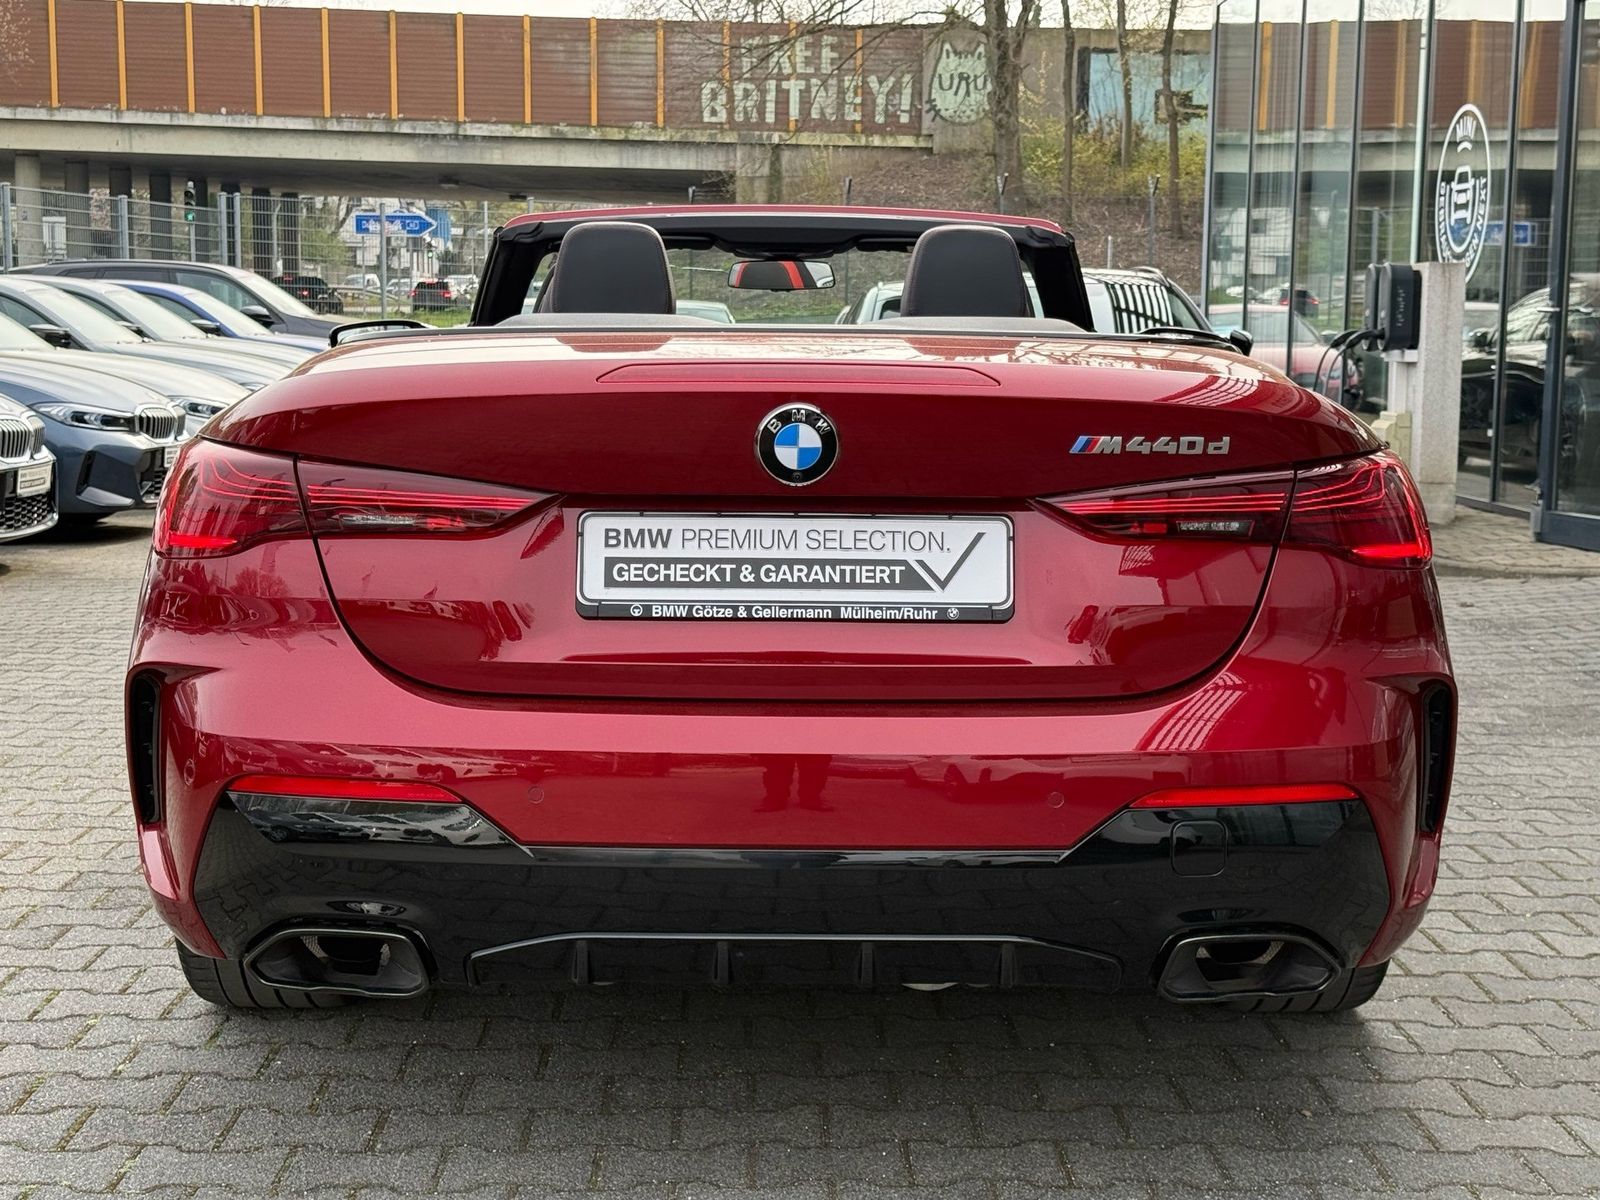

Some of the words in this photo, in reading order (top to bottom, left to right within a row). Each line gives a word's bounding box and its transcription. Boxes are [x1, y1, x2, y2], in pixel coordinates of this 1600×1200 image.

[741, 35, 841, 77] FREE
[701, 74, 912, 123] BRITNEY!
[1456, 116, 1477, 142] MINI
[1476, 176, 1488, 231] NEXT
[767, 409, 831, 435] BMW
[1091, 436, 1230, 455] M440d
[604, 528, 672, 549] BMW
[681, 529, 797, 550] PREMIUM
[805, 530, 951, 552] SELECTION.
[612, 563, 736, 582] GECHECKT
[739, 564, 755, 582] &
[760, 565, 906, 584] GARANTIERT
[652, 606, 688, 617] BMW
[692, 605, 733, 618] Götze
[737, 606, 748, 618] &
[752, 606, 832, 619] Gellermann
[840, 607, 938, 620] Mülheim/Ruhr
